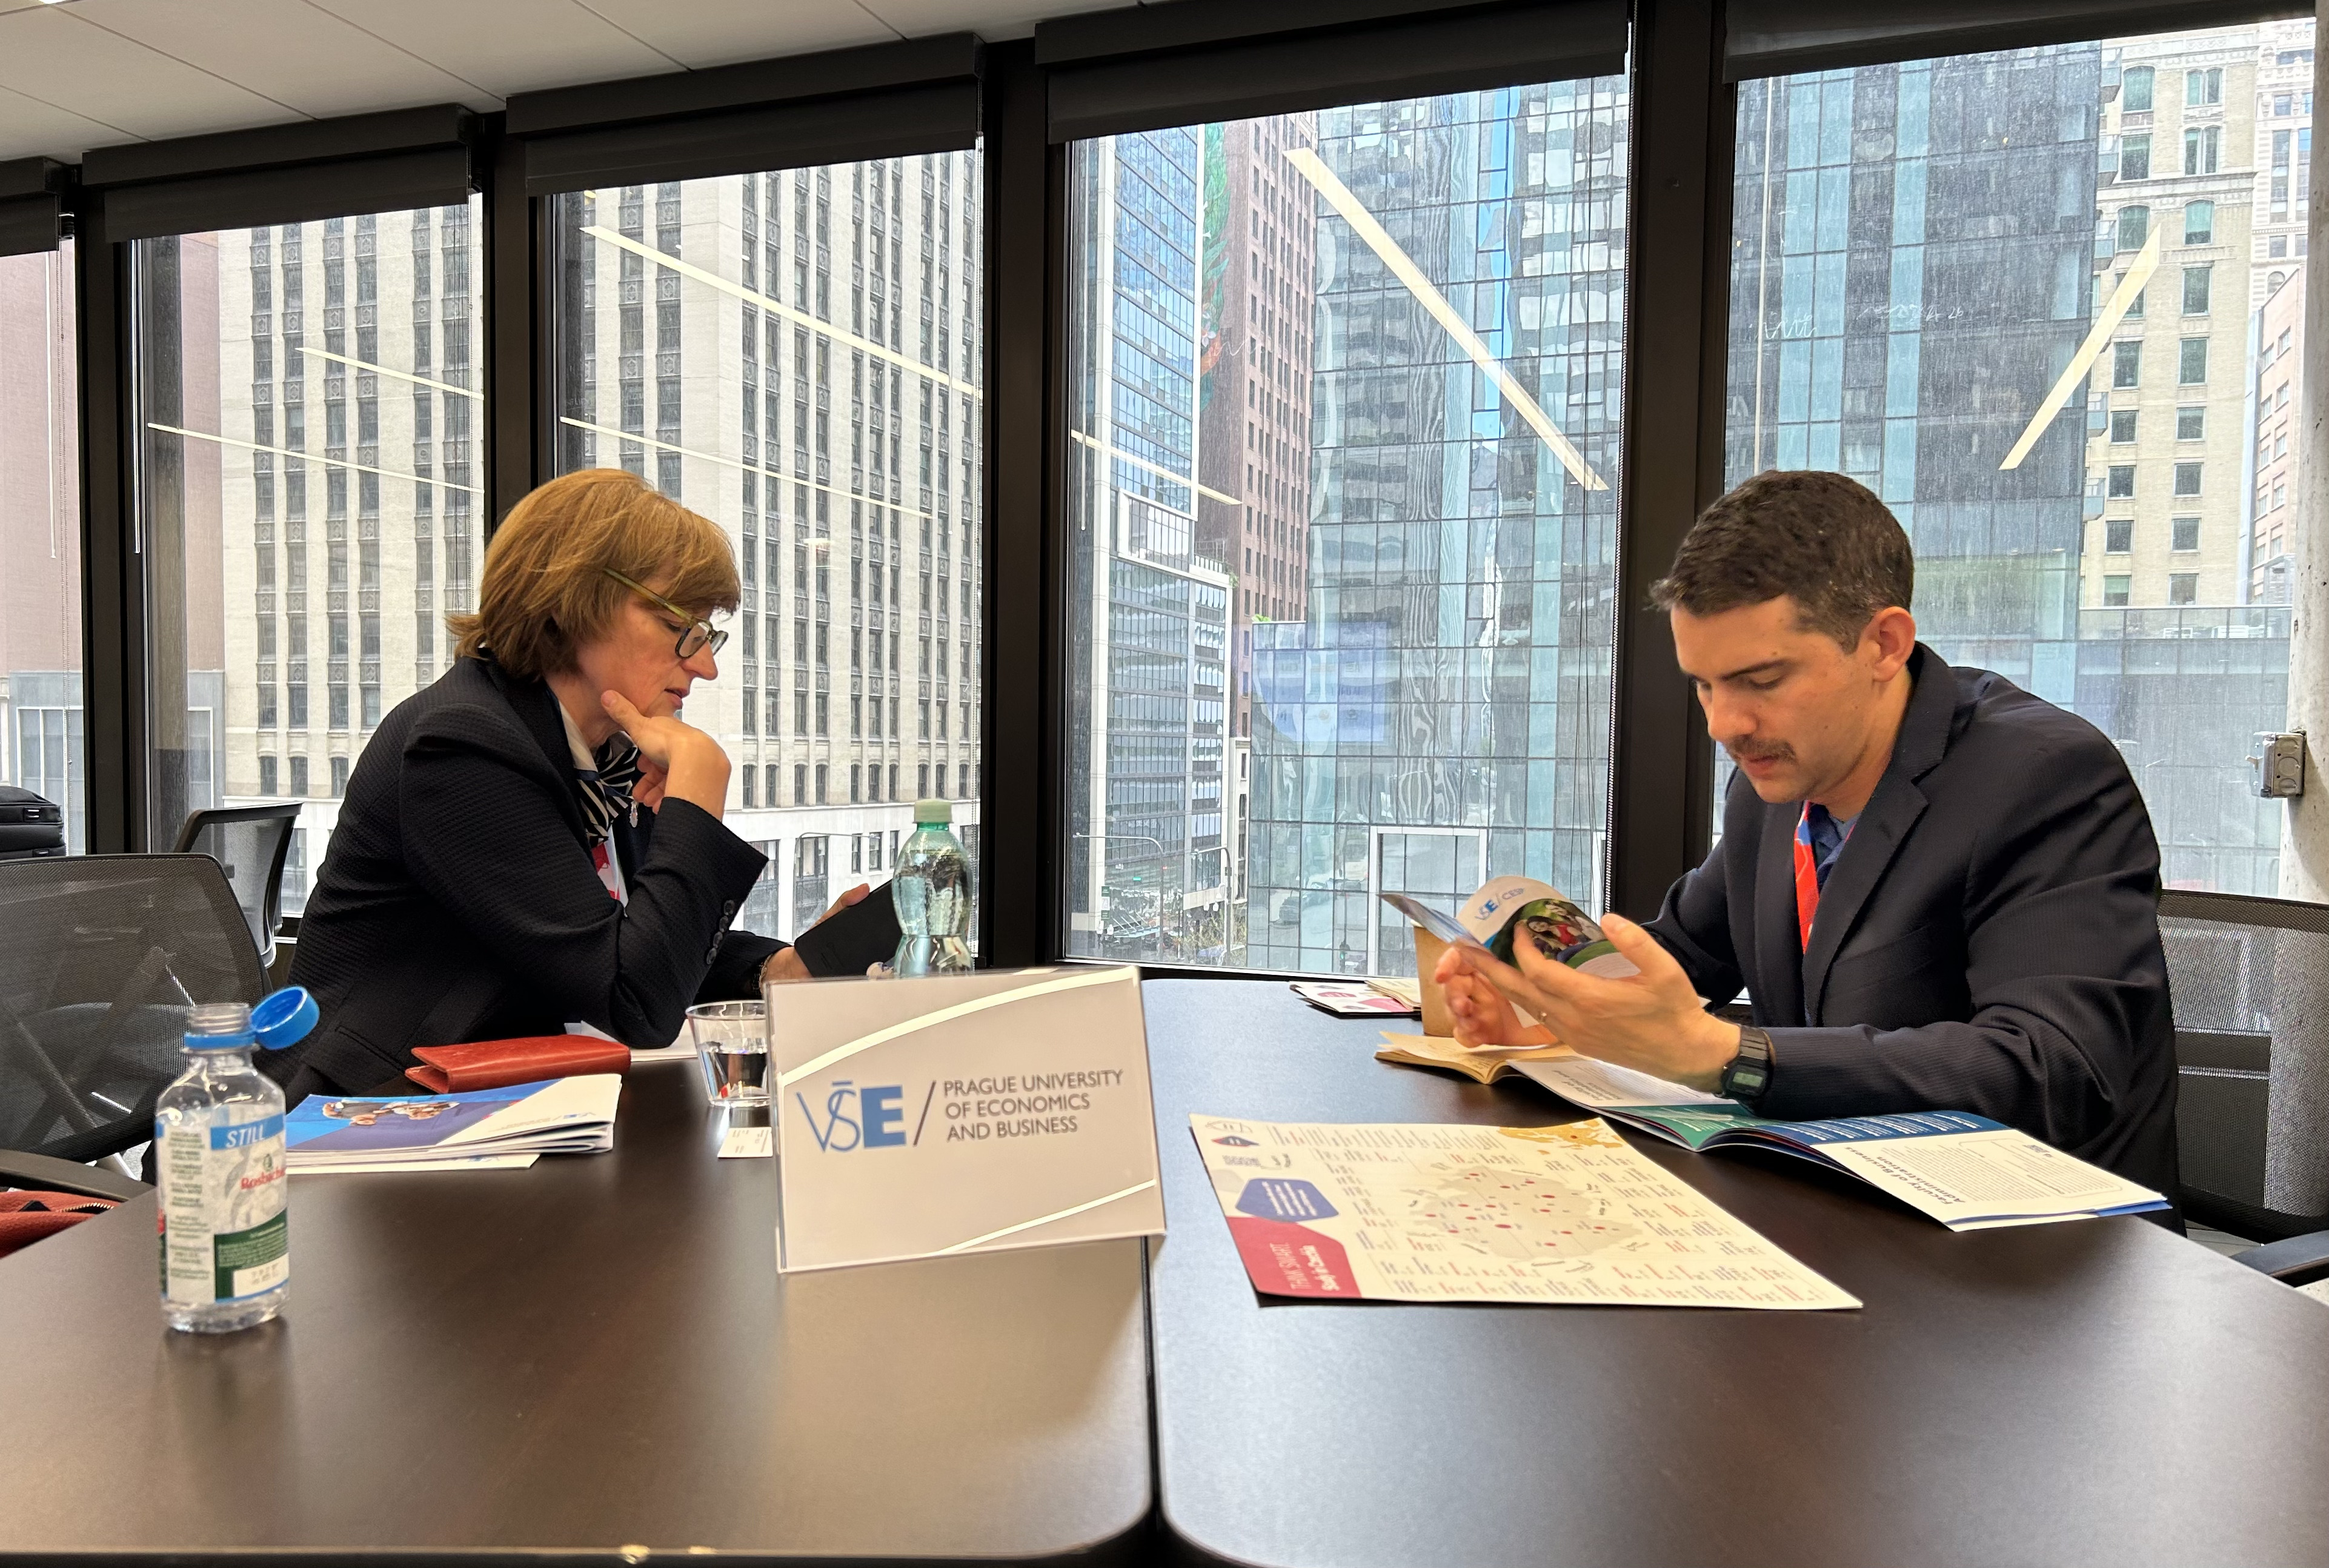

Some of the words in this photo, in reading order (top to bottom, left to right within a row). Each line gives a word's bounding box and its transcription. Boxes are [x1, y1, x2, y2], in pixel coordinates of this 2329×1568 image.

[943, 1076, 1018, 1097] PRAGUE
[1022, 1068, 1125, 1092] UNIVERSITY
[945, 1101, 972, 1120] OF
[976, 1092, 1091, 1118] ECONOMICS
[225, 1124, 265, 1148] STILL
[946, 1122, 992, 1143] AND
[997, 1115, 1078, 1139] BUSINESS
[1844, 1146, 1894, 1174] Business
[1876, 1156, 1966, 1203] Administration
[1907, 1182, 1953, 1204] Faculty
